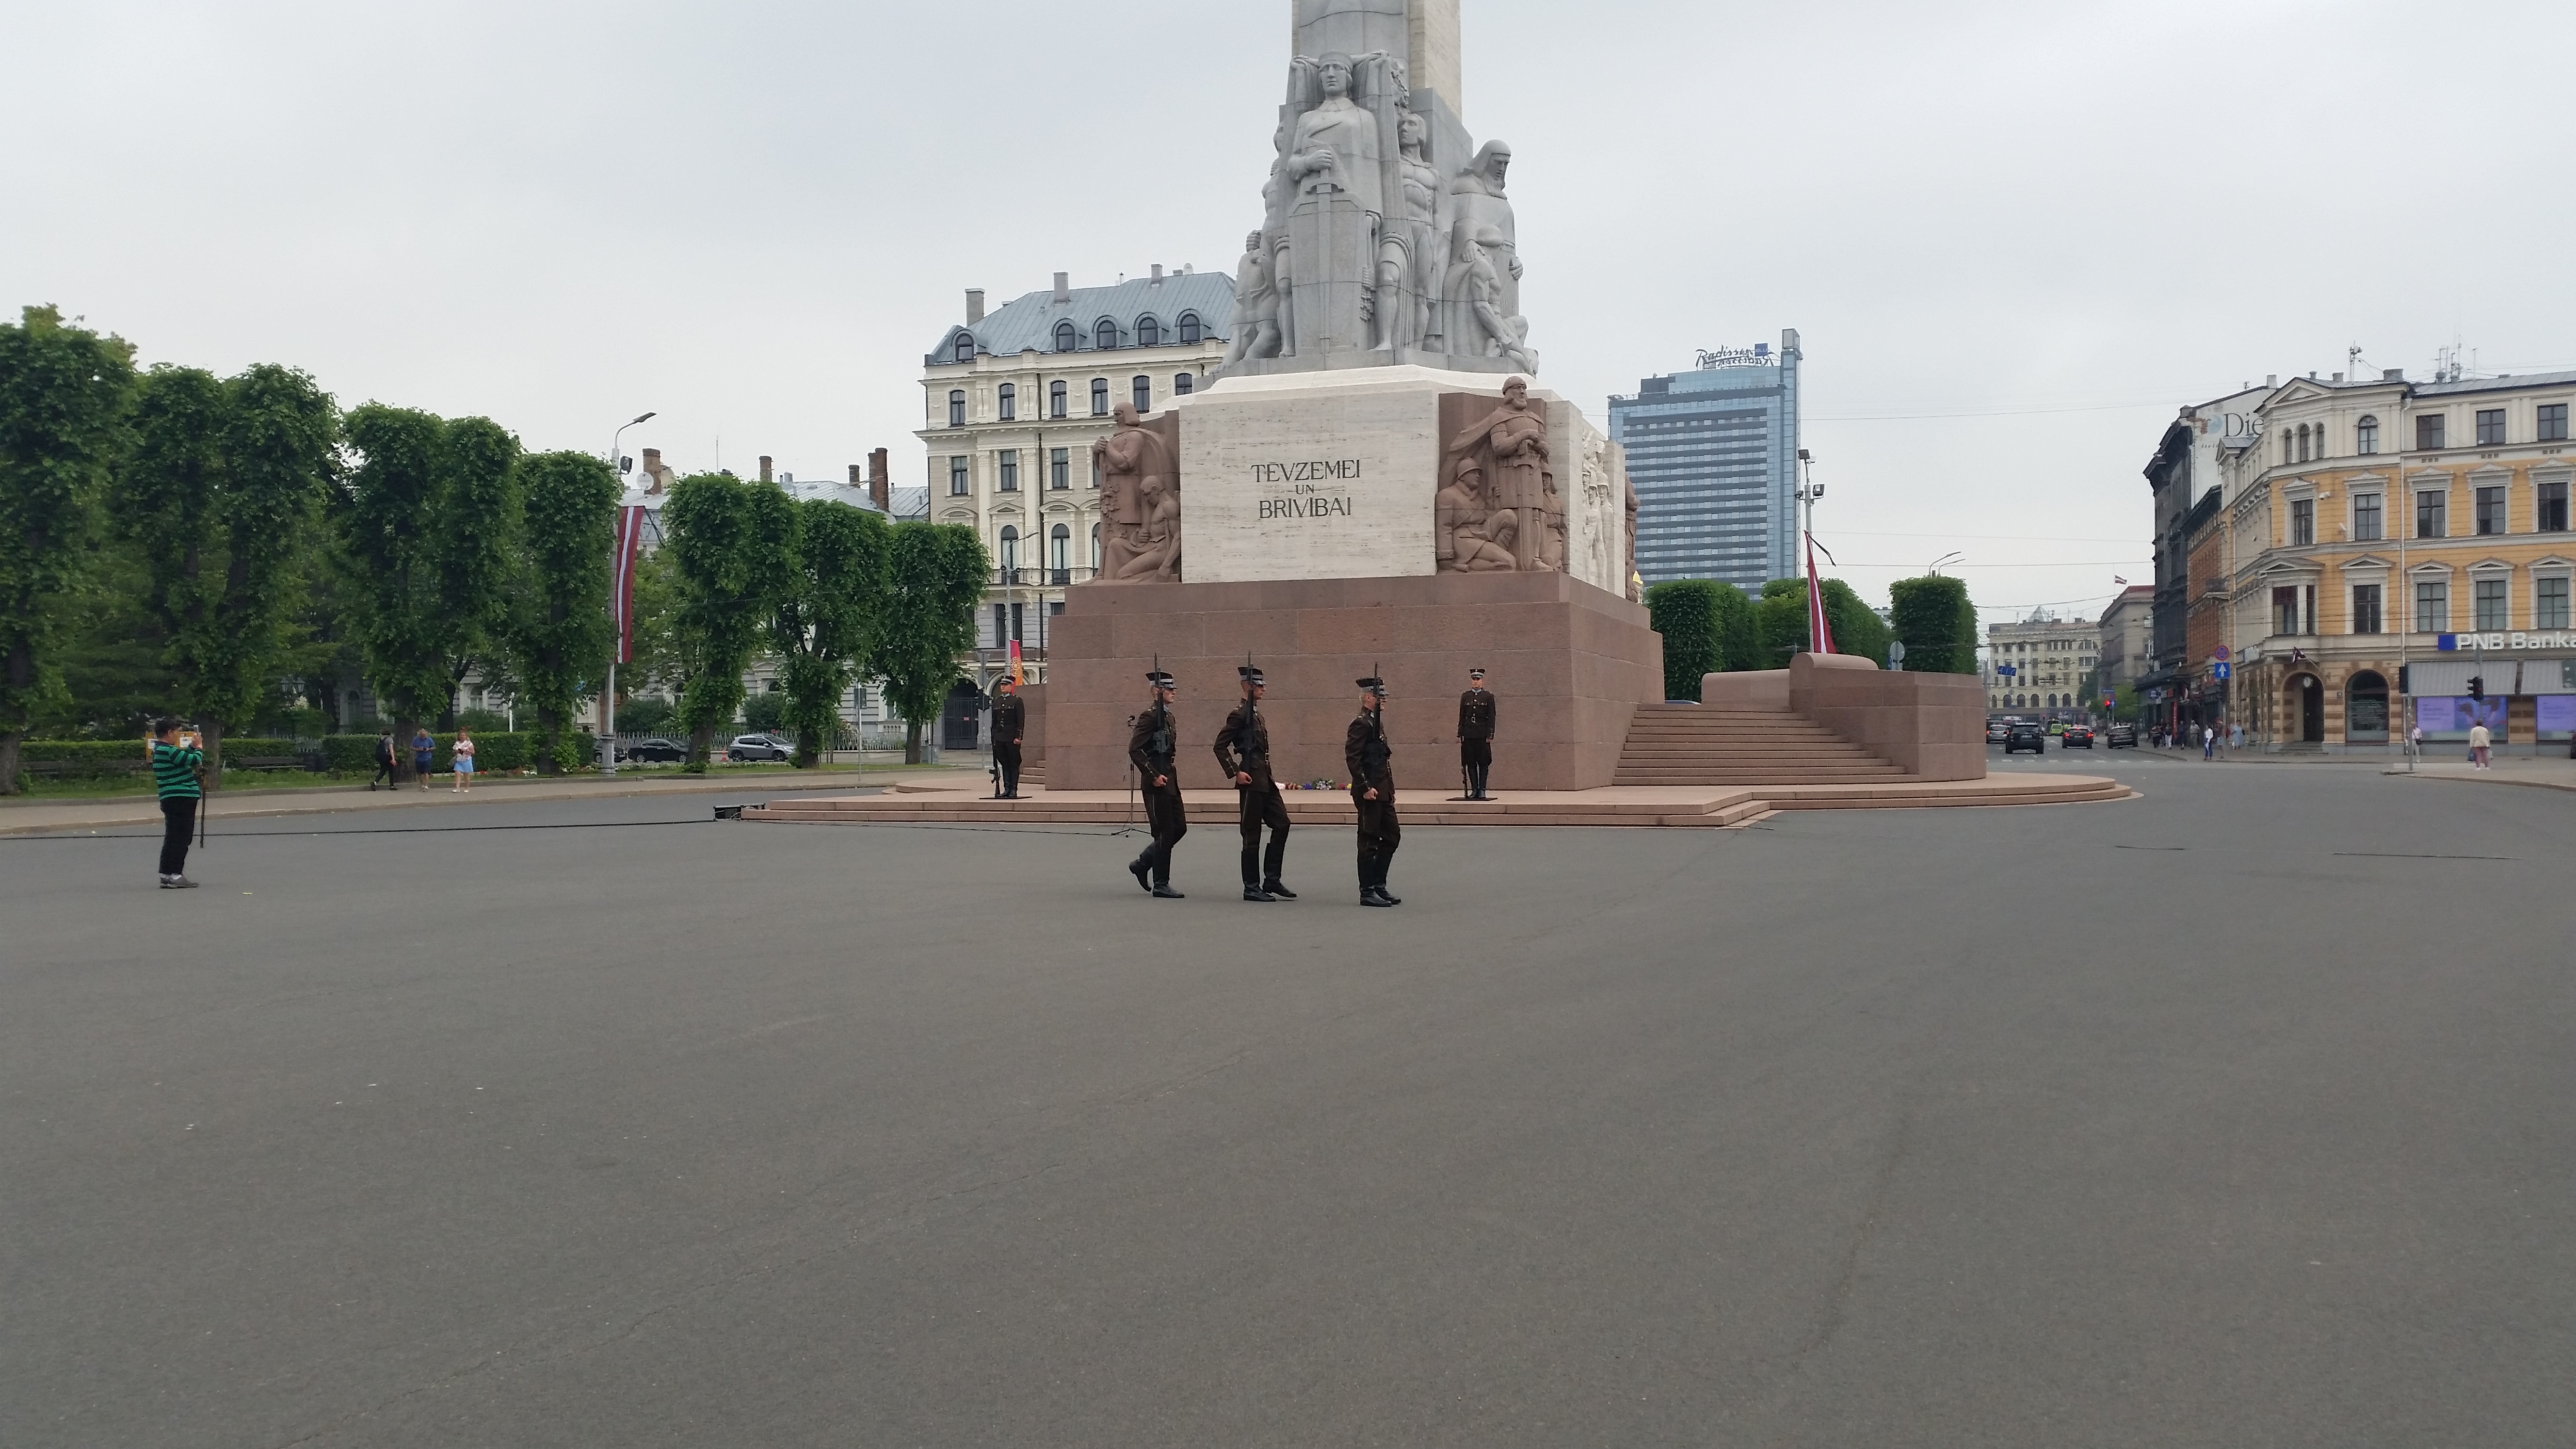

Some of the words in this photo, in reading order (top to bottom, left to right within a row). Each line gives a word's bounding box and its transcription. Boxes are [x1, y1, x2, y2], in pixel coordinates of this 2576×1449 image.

[1250, 460, 1360, 483] TĒVZEMEI
[1295, 484, 1314, 495] UN
[2457, 633, 2504, 650] PNB
